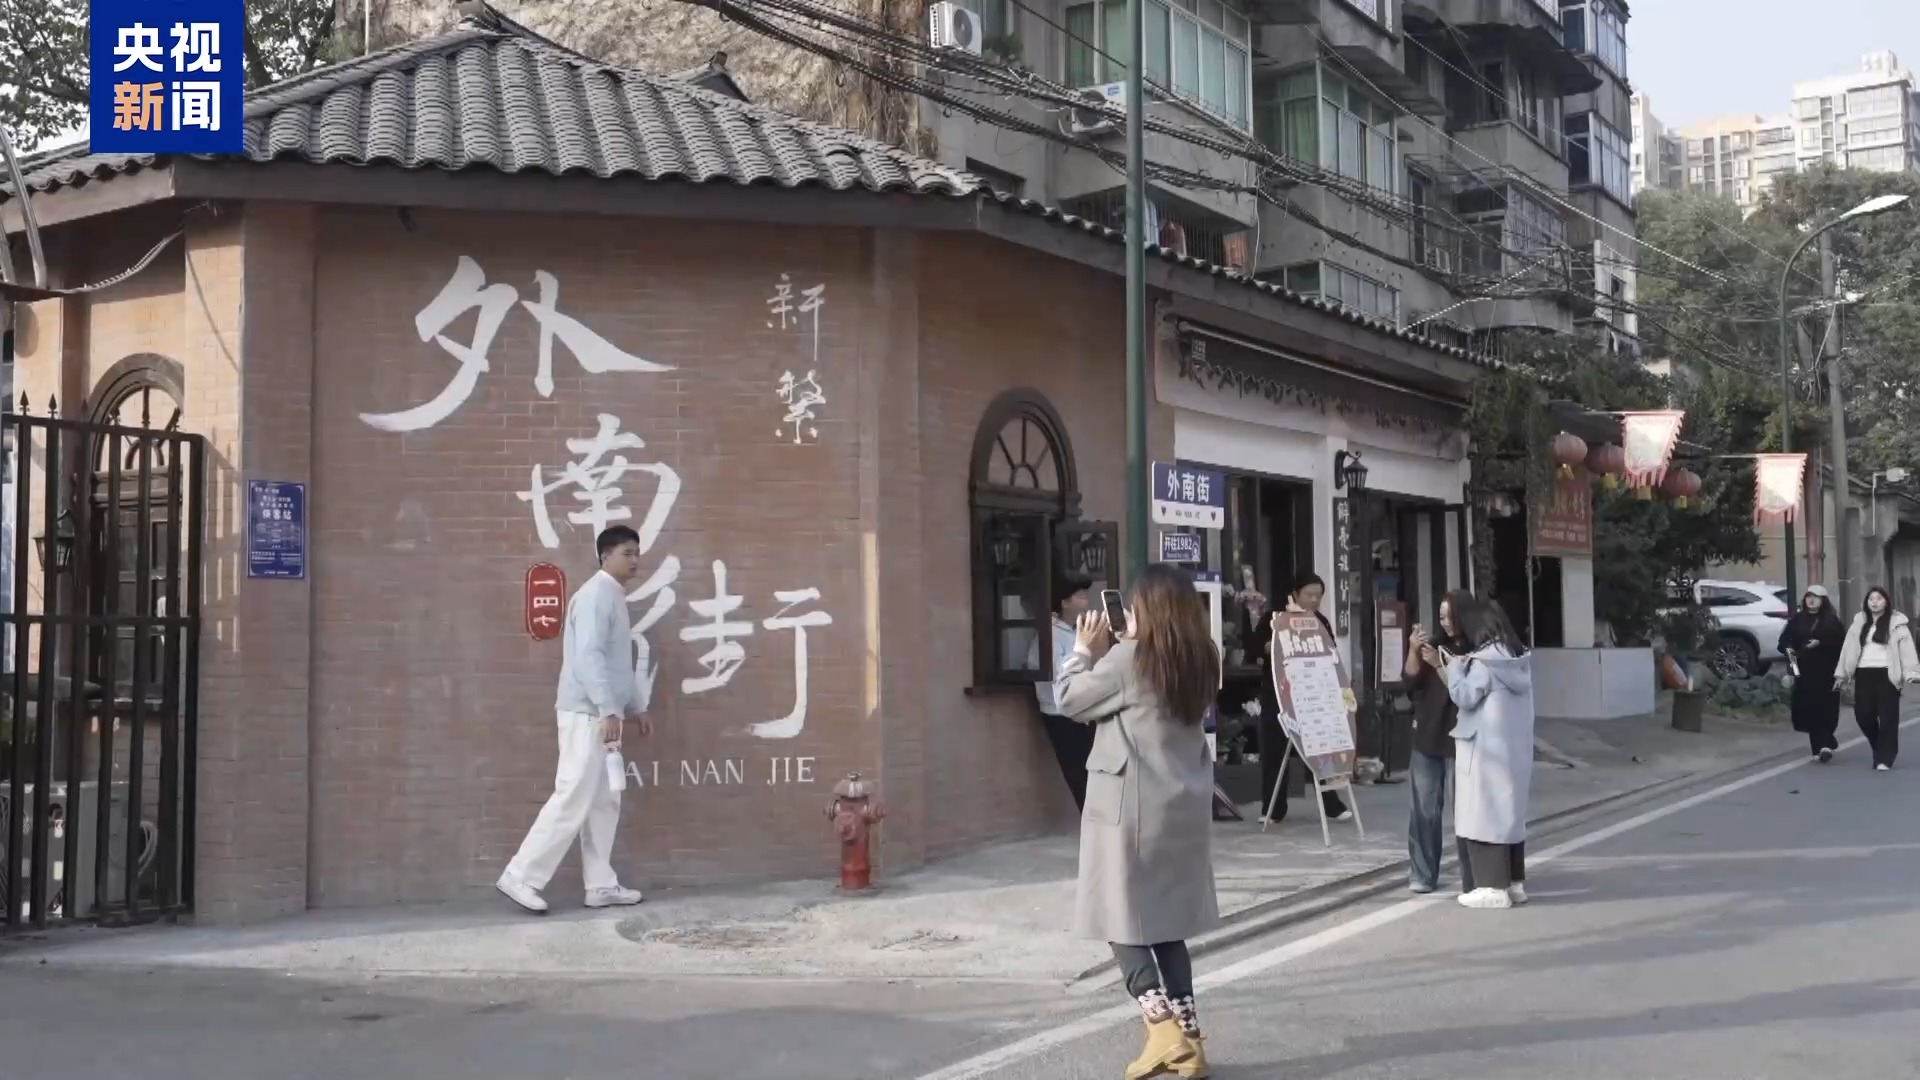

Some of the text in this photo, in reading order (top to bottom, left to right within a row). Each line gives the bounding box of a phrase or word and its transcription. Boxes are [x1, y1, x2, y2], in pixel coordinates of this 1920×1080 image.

[1167, 468, 1210, 504] 外南街
[1164, 536, 1193, 551] 开往1982
[533, 578, 560, 629] 一四七
[625, 757, 815, 787] AI NAN JIE
